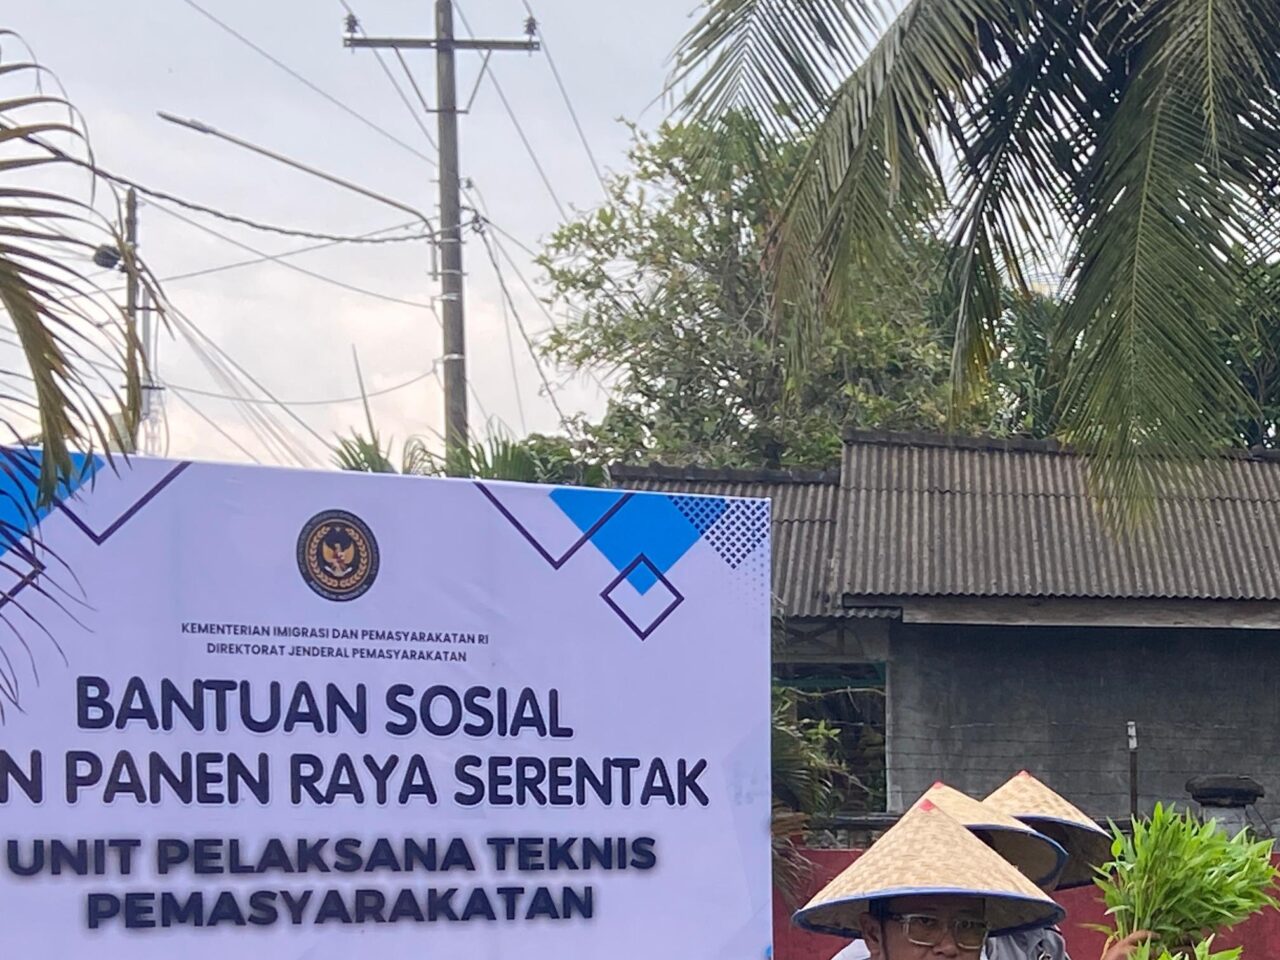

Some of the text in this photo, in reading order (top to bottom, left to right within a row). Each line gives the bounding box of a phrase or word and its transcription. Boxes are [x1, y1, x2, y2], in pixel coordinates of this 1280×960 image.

[181, 622, 490, 645] KEMENTERIAN IMIGRASI DAN PEMASYARAKATAN RI
[206, 643, 467, 662] DIREKTORAT JENDERAL PEMASYARAKATAN
[76, 675, 574, 737] BANTUAN SOSIAL
[65, 749, 269, 805] PANEN
[290, 752, 437, 805] RAYA
[454, 754, 709, 806] SERENTAK
[7, 837, 657, 876] UNIT PELAKSANA TEKNIS
[87, 886, 594, 929] PEMASYARAKATAN
